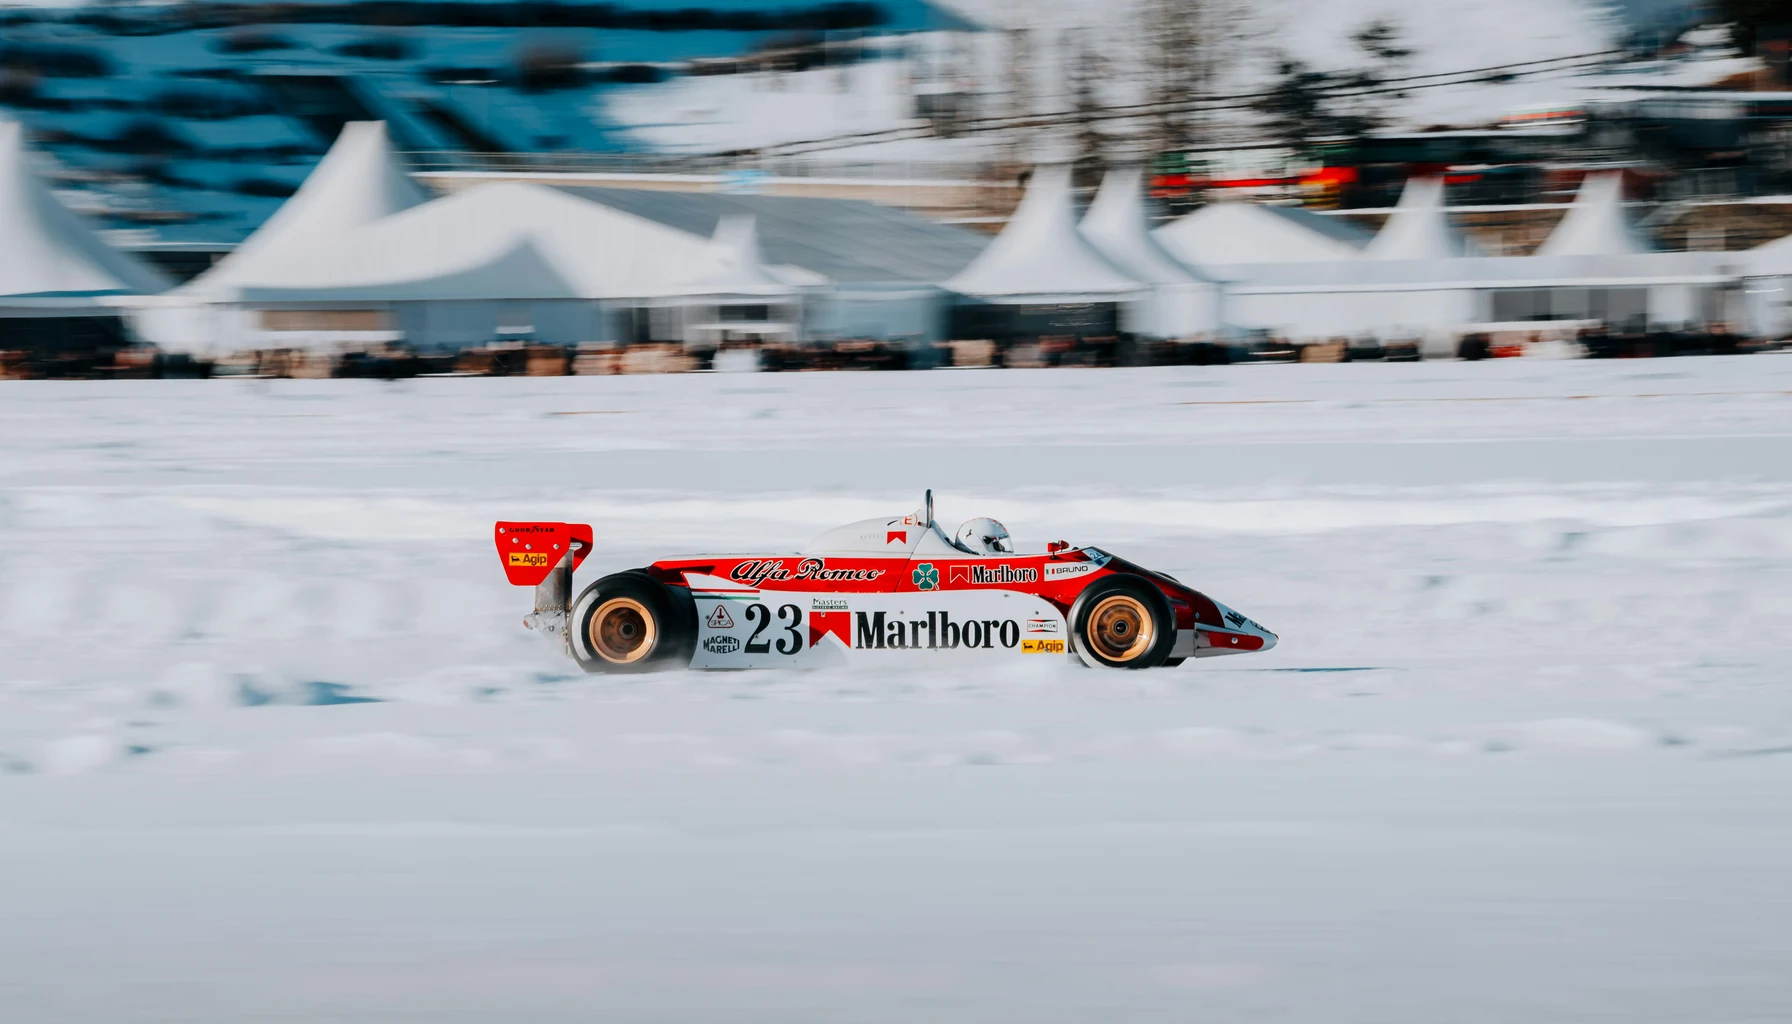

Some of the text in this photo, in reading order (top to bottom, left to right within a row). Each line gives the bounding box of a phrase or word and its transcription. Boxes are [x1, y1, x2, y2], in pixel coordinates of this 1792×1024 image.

[522, 553, 547, 566] Agip
[731, 556, 886, 588] Alfa Romeo
[971, 565, 1038, 584] Marlboro
[1056, 565, 1089, 575] BRUNO
[812, 597, 848, 605] Masters
[743, 603, 803, 655] 23
[855, 611, 1020, 650] Marlboro
[1036, 640, 1064, 653] Agip
